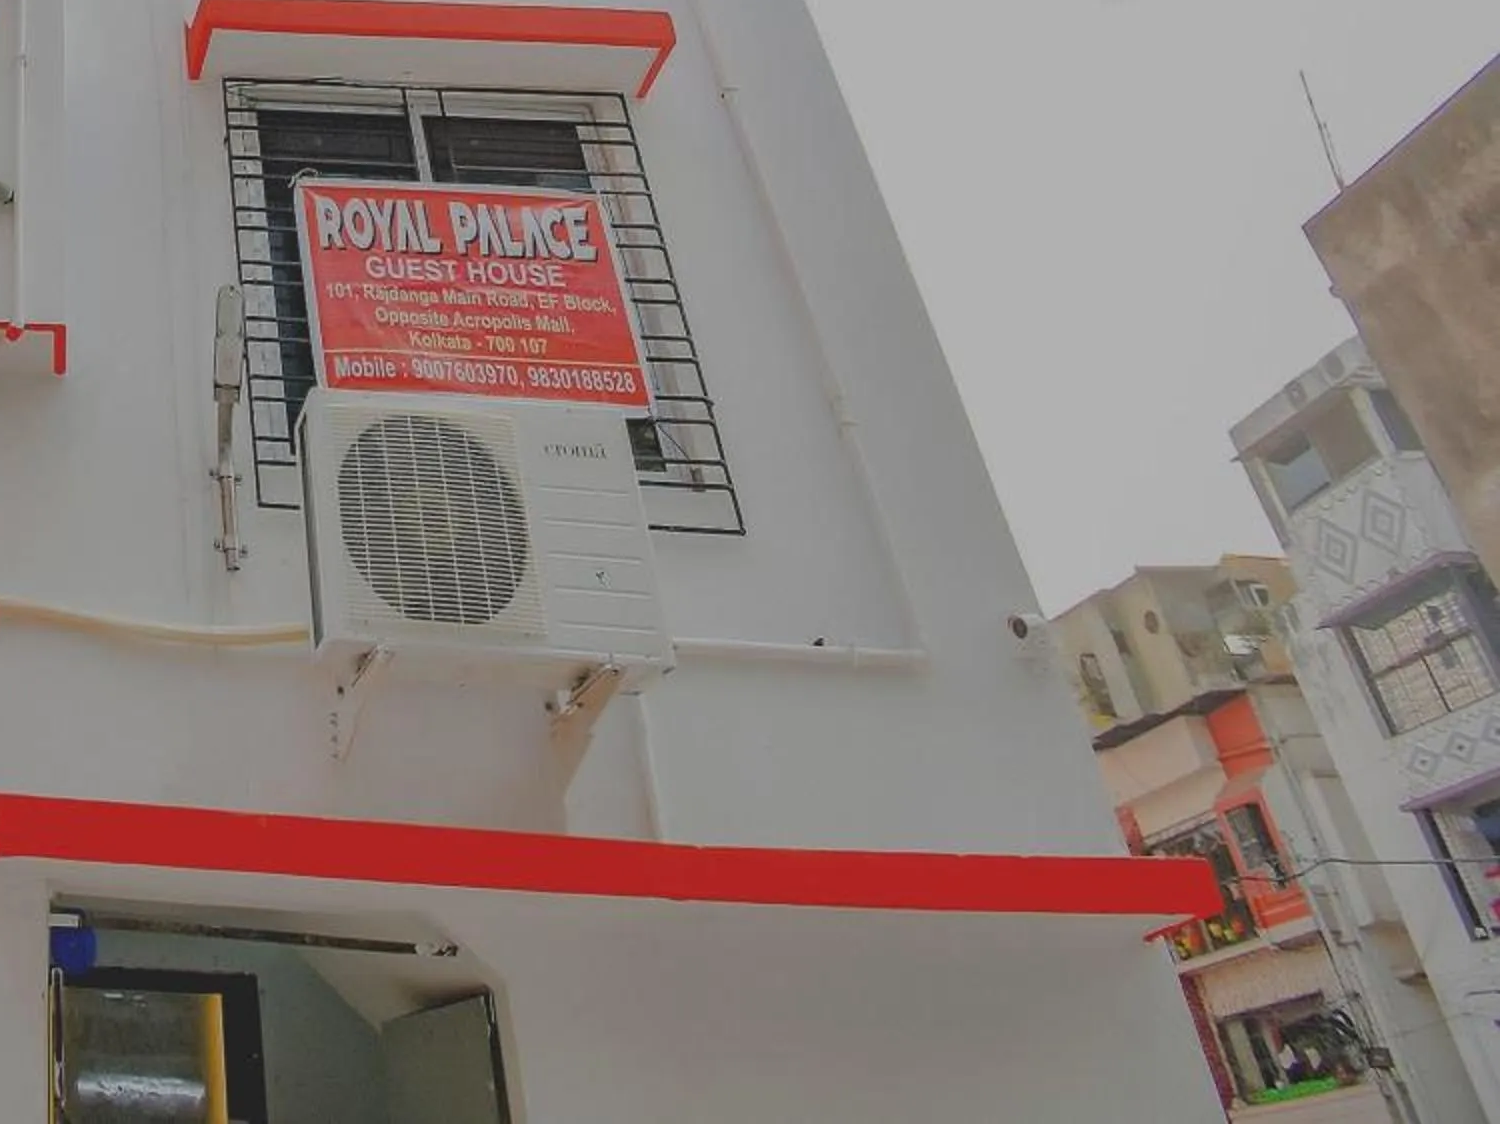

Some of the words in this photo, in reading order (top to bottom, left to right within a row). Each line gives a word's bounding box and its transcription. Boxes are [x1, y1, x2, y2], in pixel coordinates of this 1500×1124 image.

[315, 196, 443, 255] ROYAL
[447, 200, 598, 262] PALACE
[365, 255, 458, 281] GUEST
[467, 259, 567, 288] HOUSE
[442, 287, 481, 305] Main
[538, 292, 559, 309] EF
[375, 306, 449, 327] Opposite
[453, 311, 533, 332] Acropolis
[409, 330, 472, 350] Kolkata
[334, 354, 397, 379] Mobile
